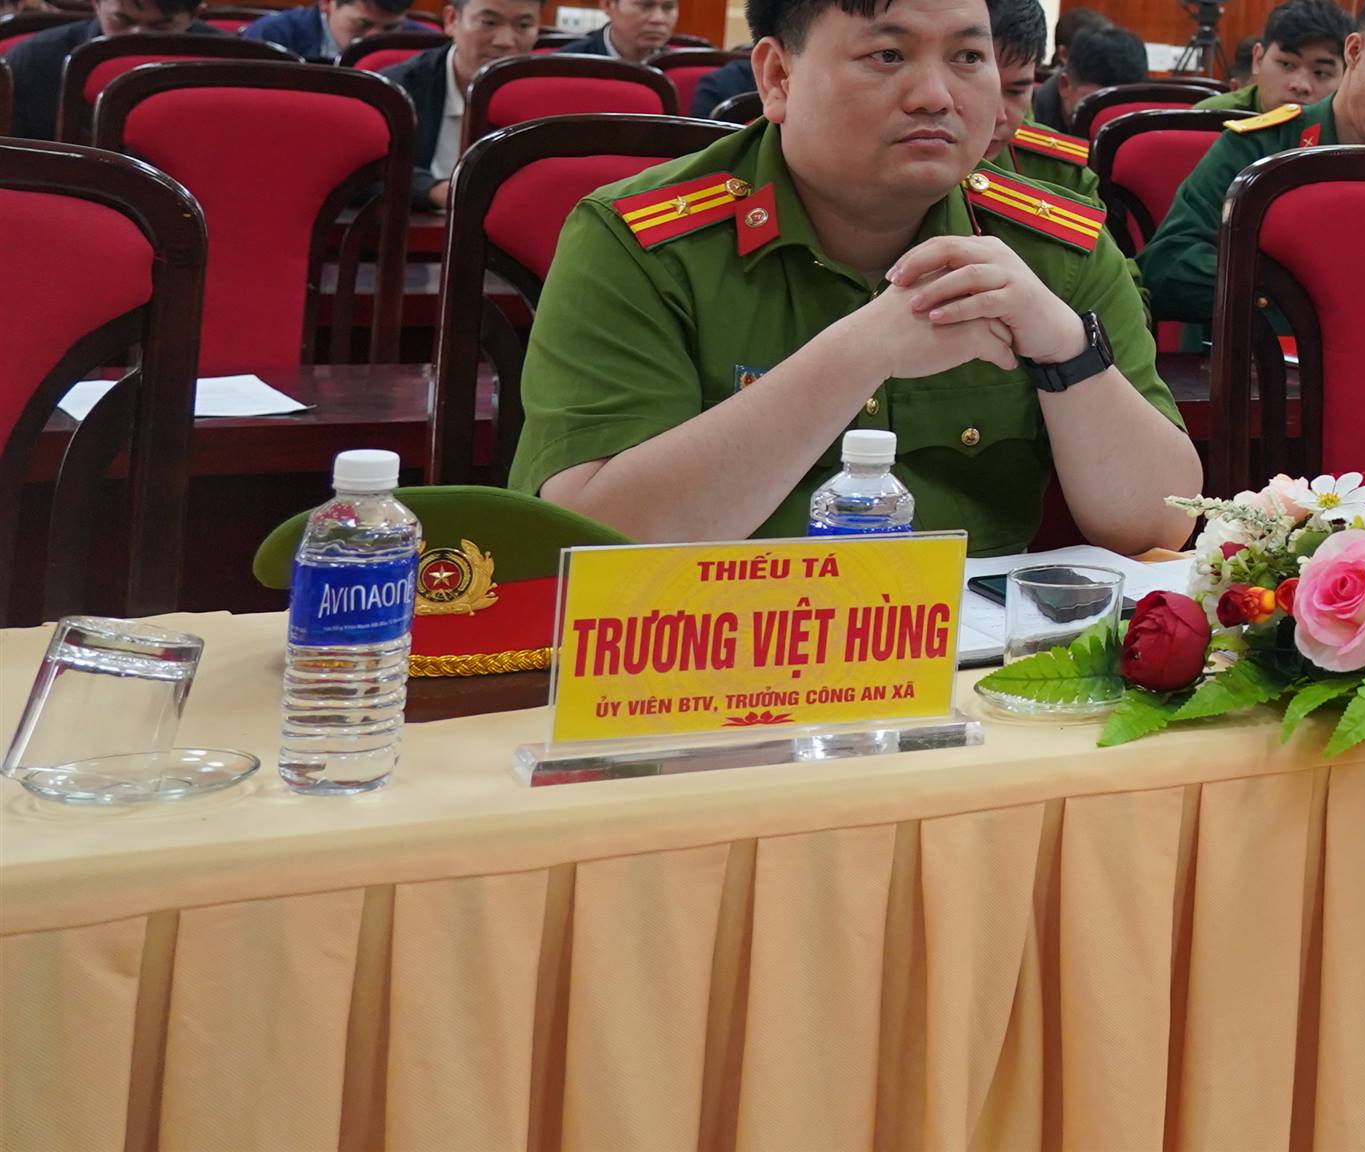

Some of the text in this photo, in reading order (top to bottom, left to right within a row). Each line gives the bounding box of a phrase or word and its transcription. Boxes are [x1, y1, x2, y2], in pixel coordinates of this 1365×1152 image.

[697, 552, 840, 582] THIẾU TÁ
[573, 593, 951, 679] TRƯƠNG VIỆT HÙNG
[595, 681, 915, 718] ỦY VIÊN BTV, TRƯỞNG CÔNG AN XÃ
